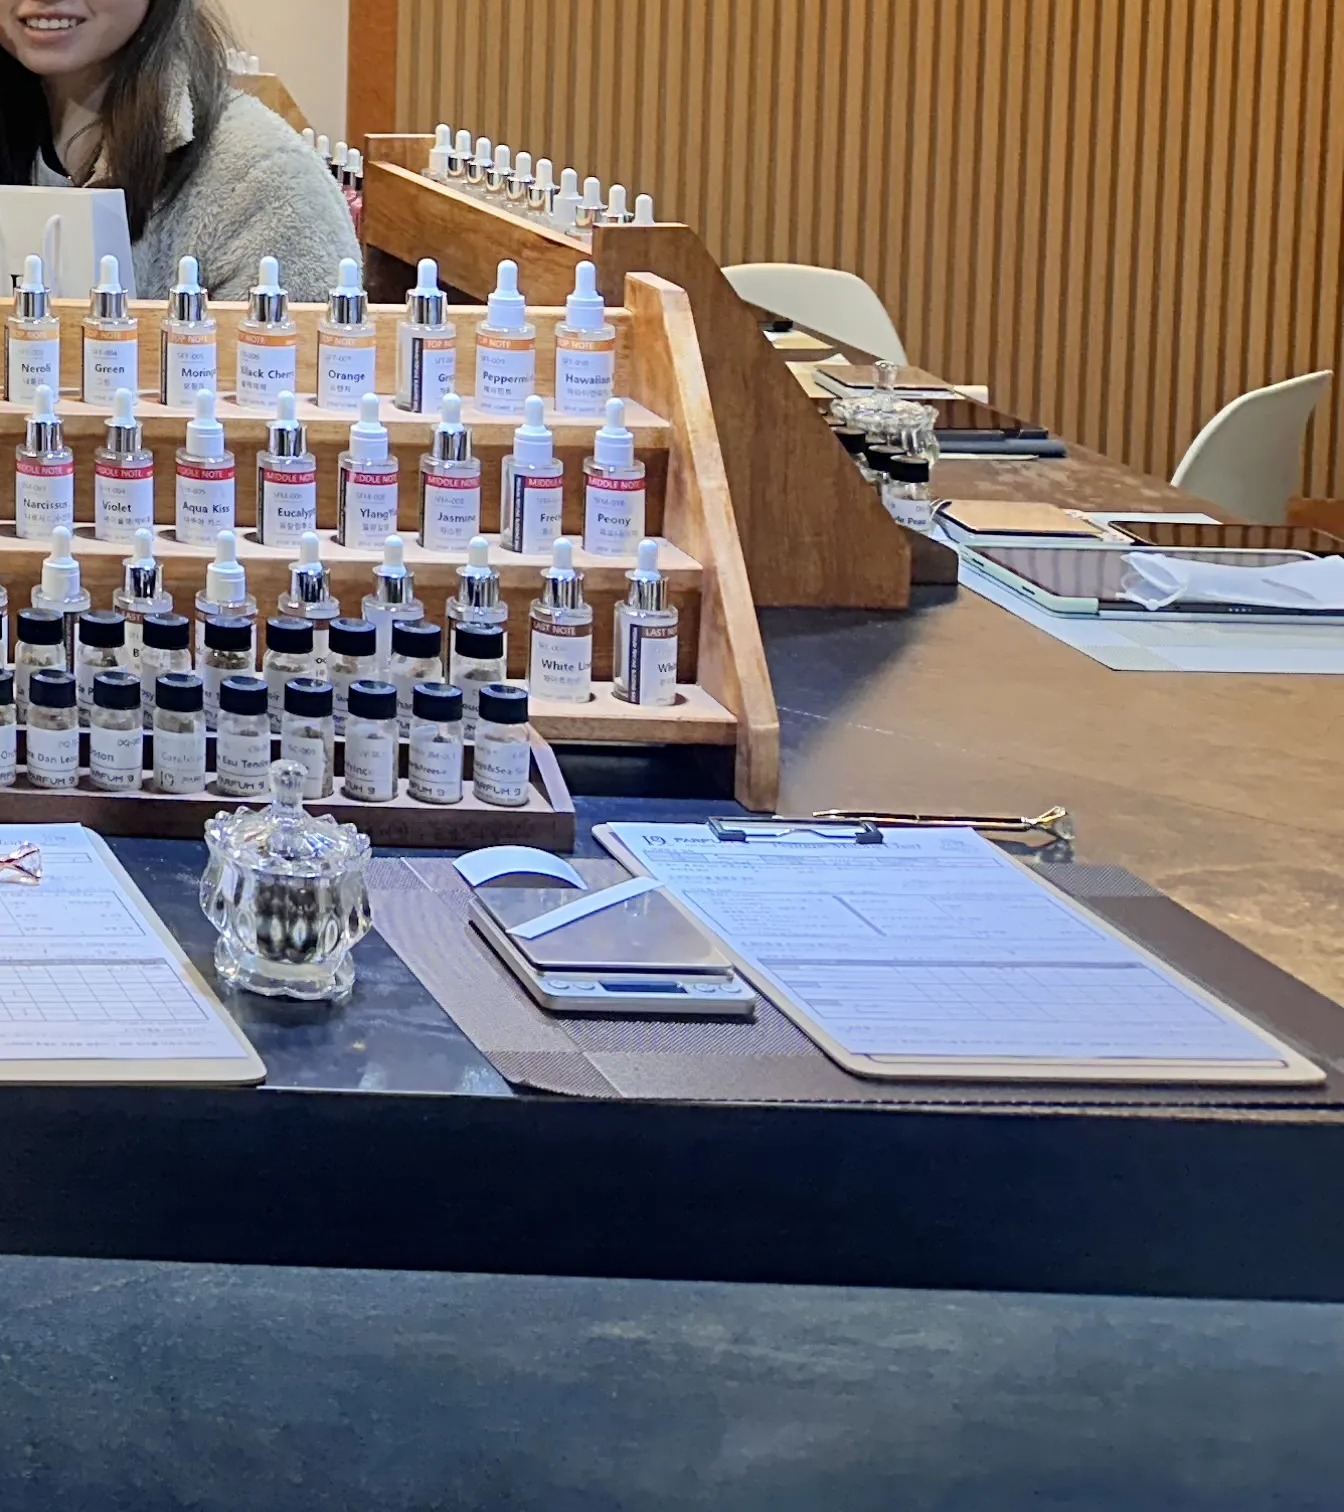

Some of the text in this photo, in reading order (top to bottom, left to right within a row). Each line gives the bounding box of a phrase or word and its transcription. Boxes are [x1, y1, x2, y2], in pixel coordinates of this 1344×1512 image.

[489, 340, 510, 350] NOTE
[571, 340, 592, 350] NOTE
[95, 364, 125, 374] Green
[328, 369, 365, 383] Orange
[121, 468, 143, 478] NOTE
[201, 469, 223, 479] NOTE
[100, 500, 132, 514] Violet
[182, 502, 230, 515] Aqua Kiss
[436, 511, 477, 523] Jasmine
[597, 513, 632, 526] Peony
[907, 517, 927, 526] Peau
[551, 624, 576, 636] NOTE
[645, 628, 666, 637] LAST
[541, 658, 574, 672] White
[38, 751, 58, 763] Dan
